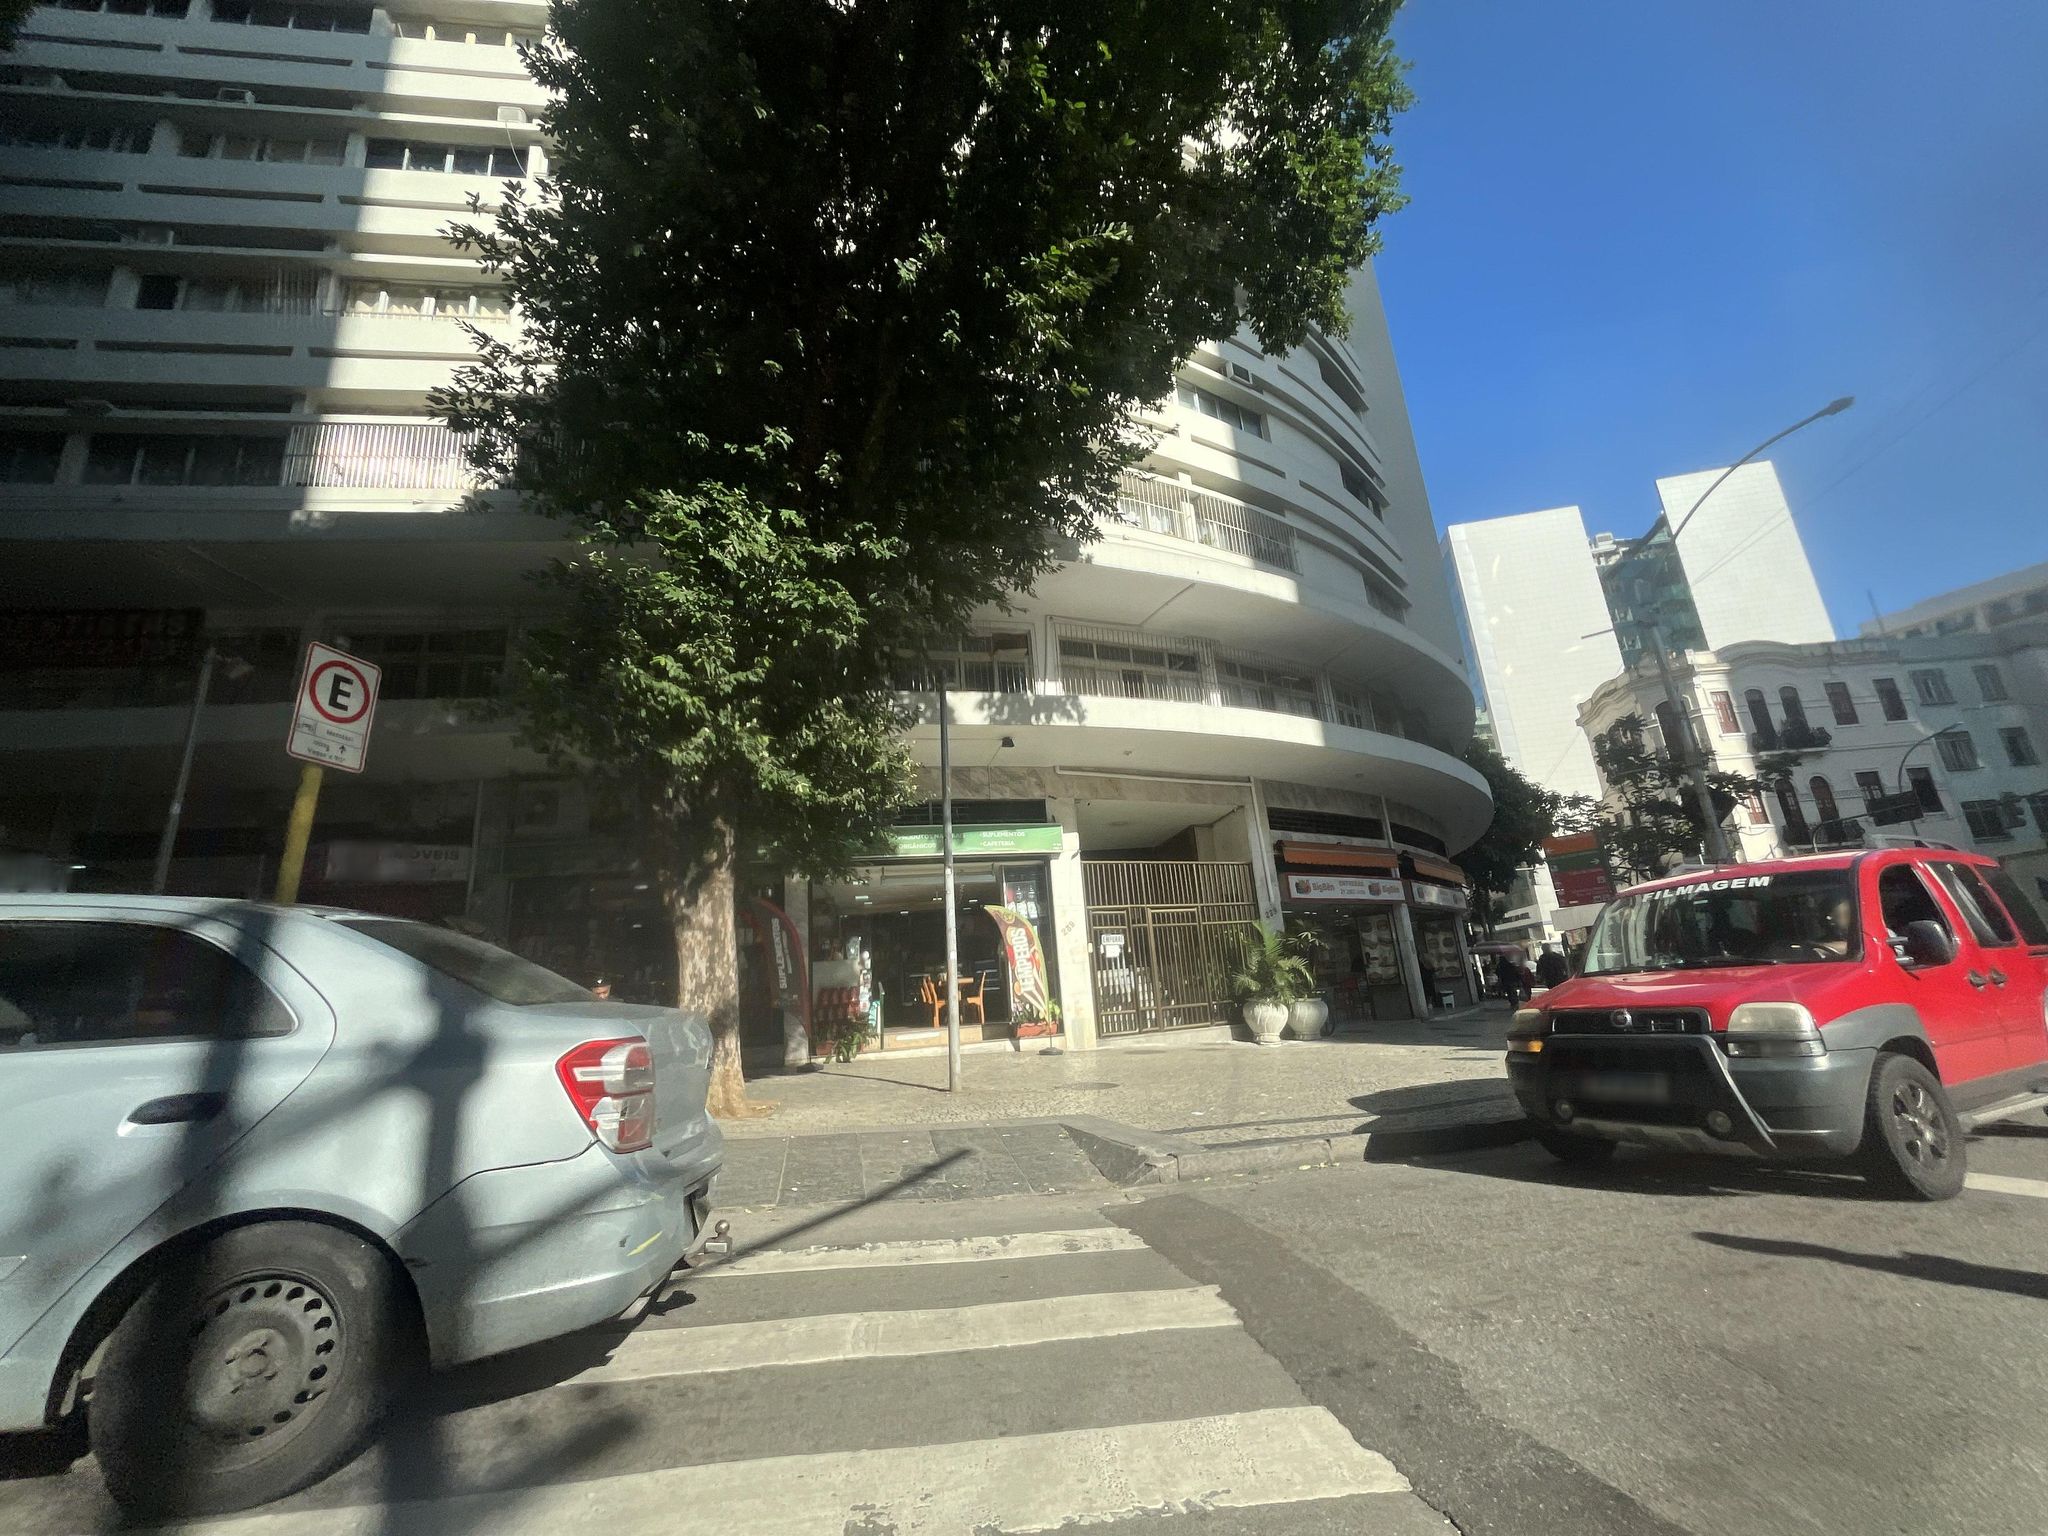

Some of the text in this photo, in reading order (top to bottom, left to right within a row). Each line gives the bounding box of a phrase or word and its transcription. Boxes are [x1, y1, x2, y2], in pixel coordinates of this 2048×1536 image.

[328, 673, 354, 712] E
[1641, 876, 1771, 903] FILMAGEM
[771, 917, 788, 990] SUPLEMENTOS
[1011, 927, 1035, 992] TEMPEROS
